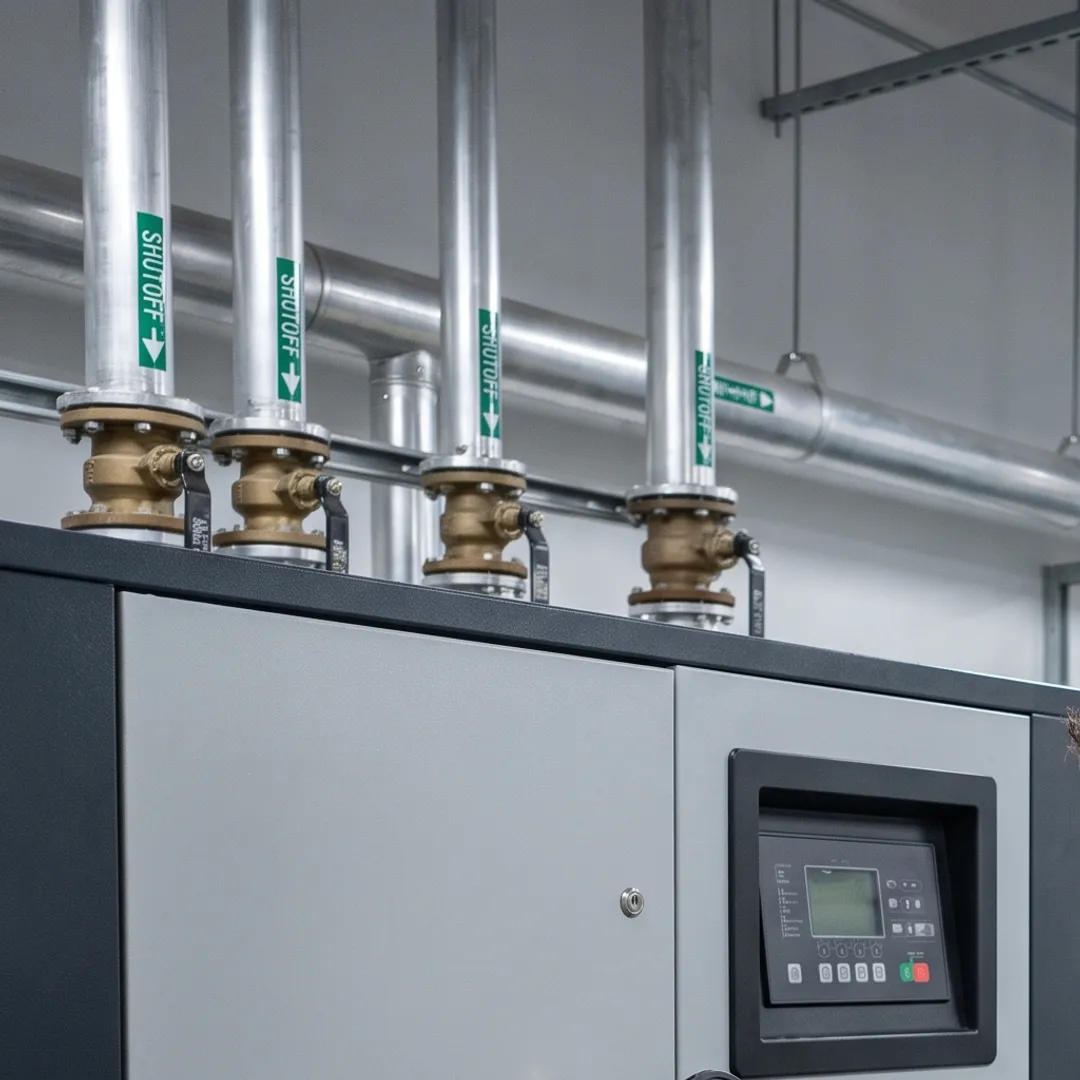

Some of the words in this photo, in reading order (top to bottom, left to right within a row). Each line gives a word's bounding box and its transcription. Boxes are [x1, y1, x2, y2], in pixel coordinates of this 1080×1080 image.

[141, 229, 164, 323] SHUTOFF
[280, 273, 300, 359] SHUTOFF
[481, 323, 498, 400] SHUTOFF
[697, 363, 712, 436] SHUTOFF
